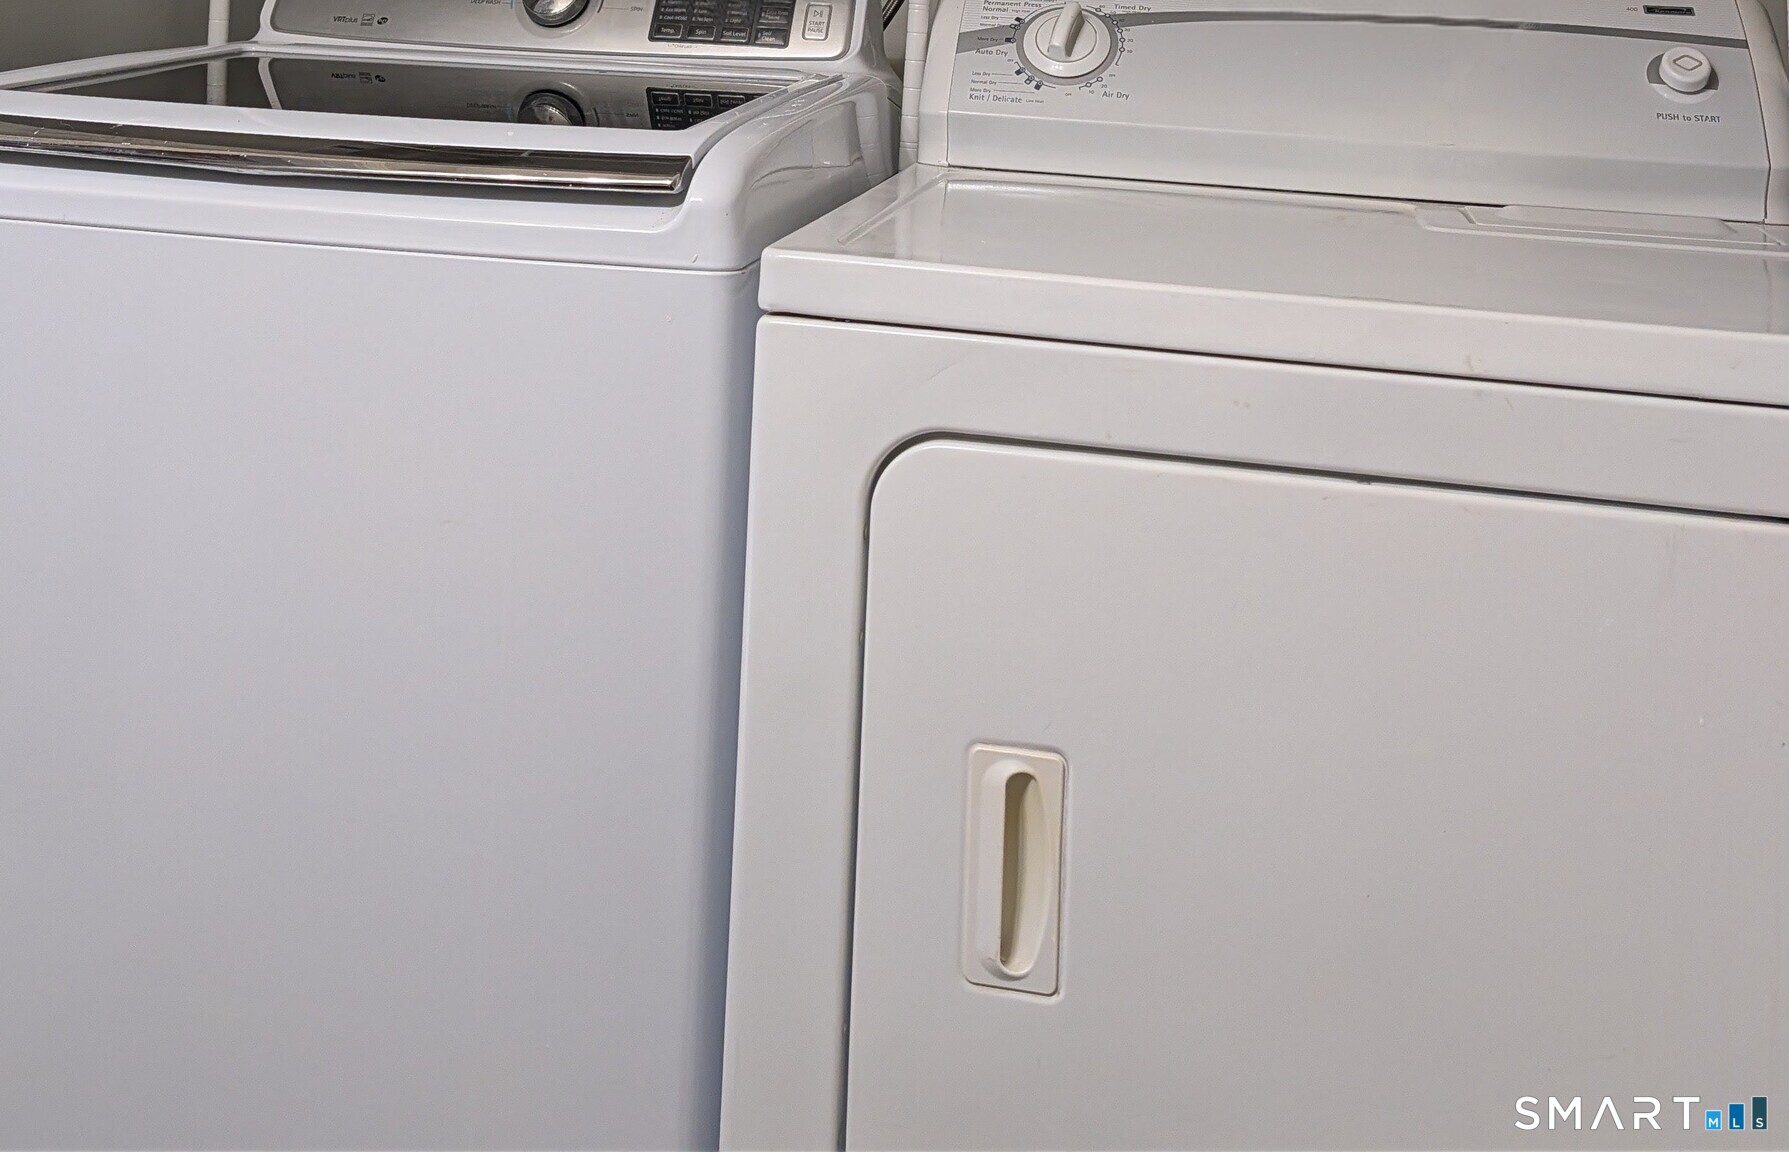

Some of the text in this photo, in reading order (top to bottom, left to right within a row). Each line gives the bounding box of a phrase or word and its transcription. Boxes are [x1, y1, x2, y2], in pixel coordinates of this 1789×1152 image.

[975, 48, 1008, 57] Auto Dry
[969, 93, 985, 101] Knit
[993, 94, 1023, 103] Delicate
[1116, 92, 1130, 100] Dry
[1656, 112, 1720, 123] PUSH to START
